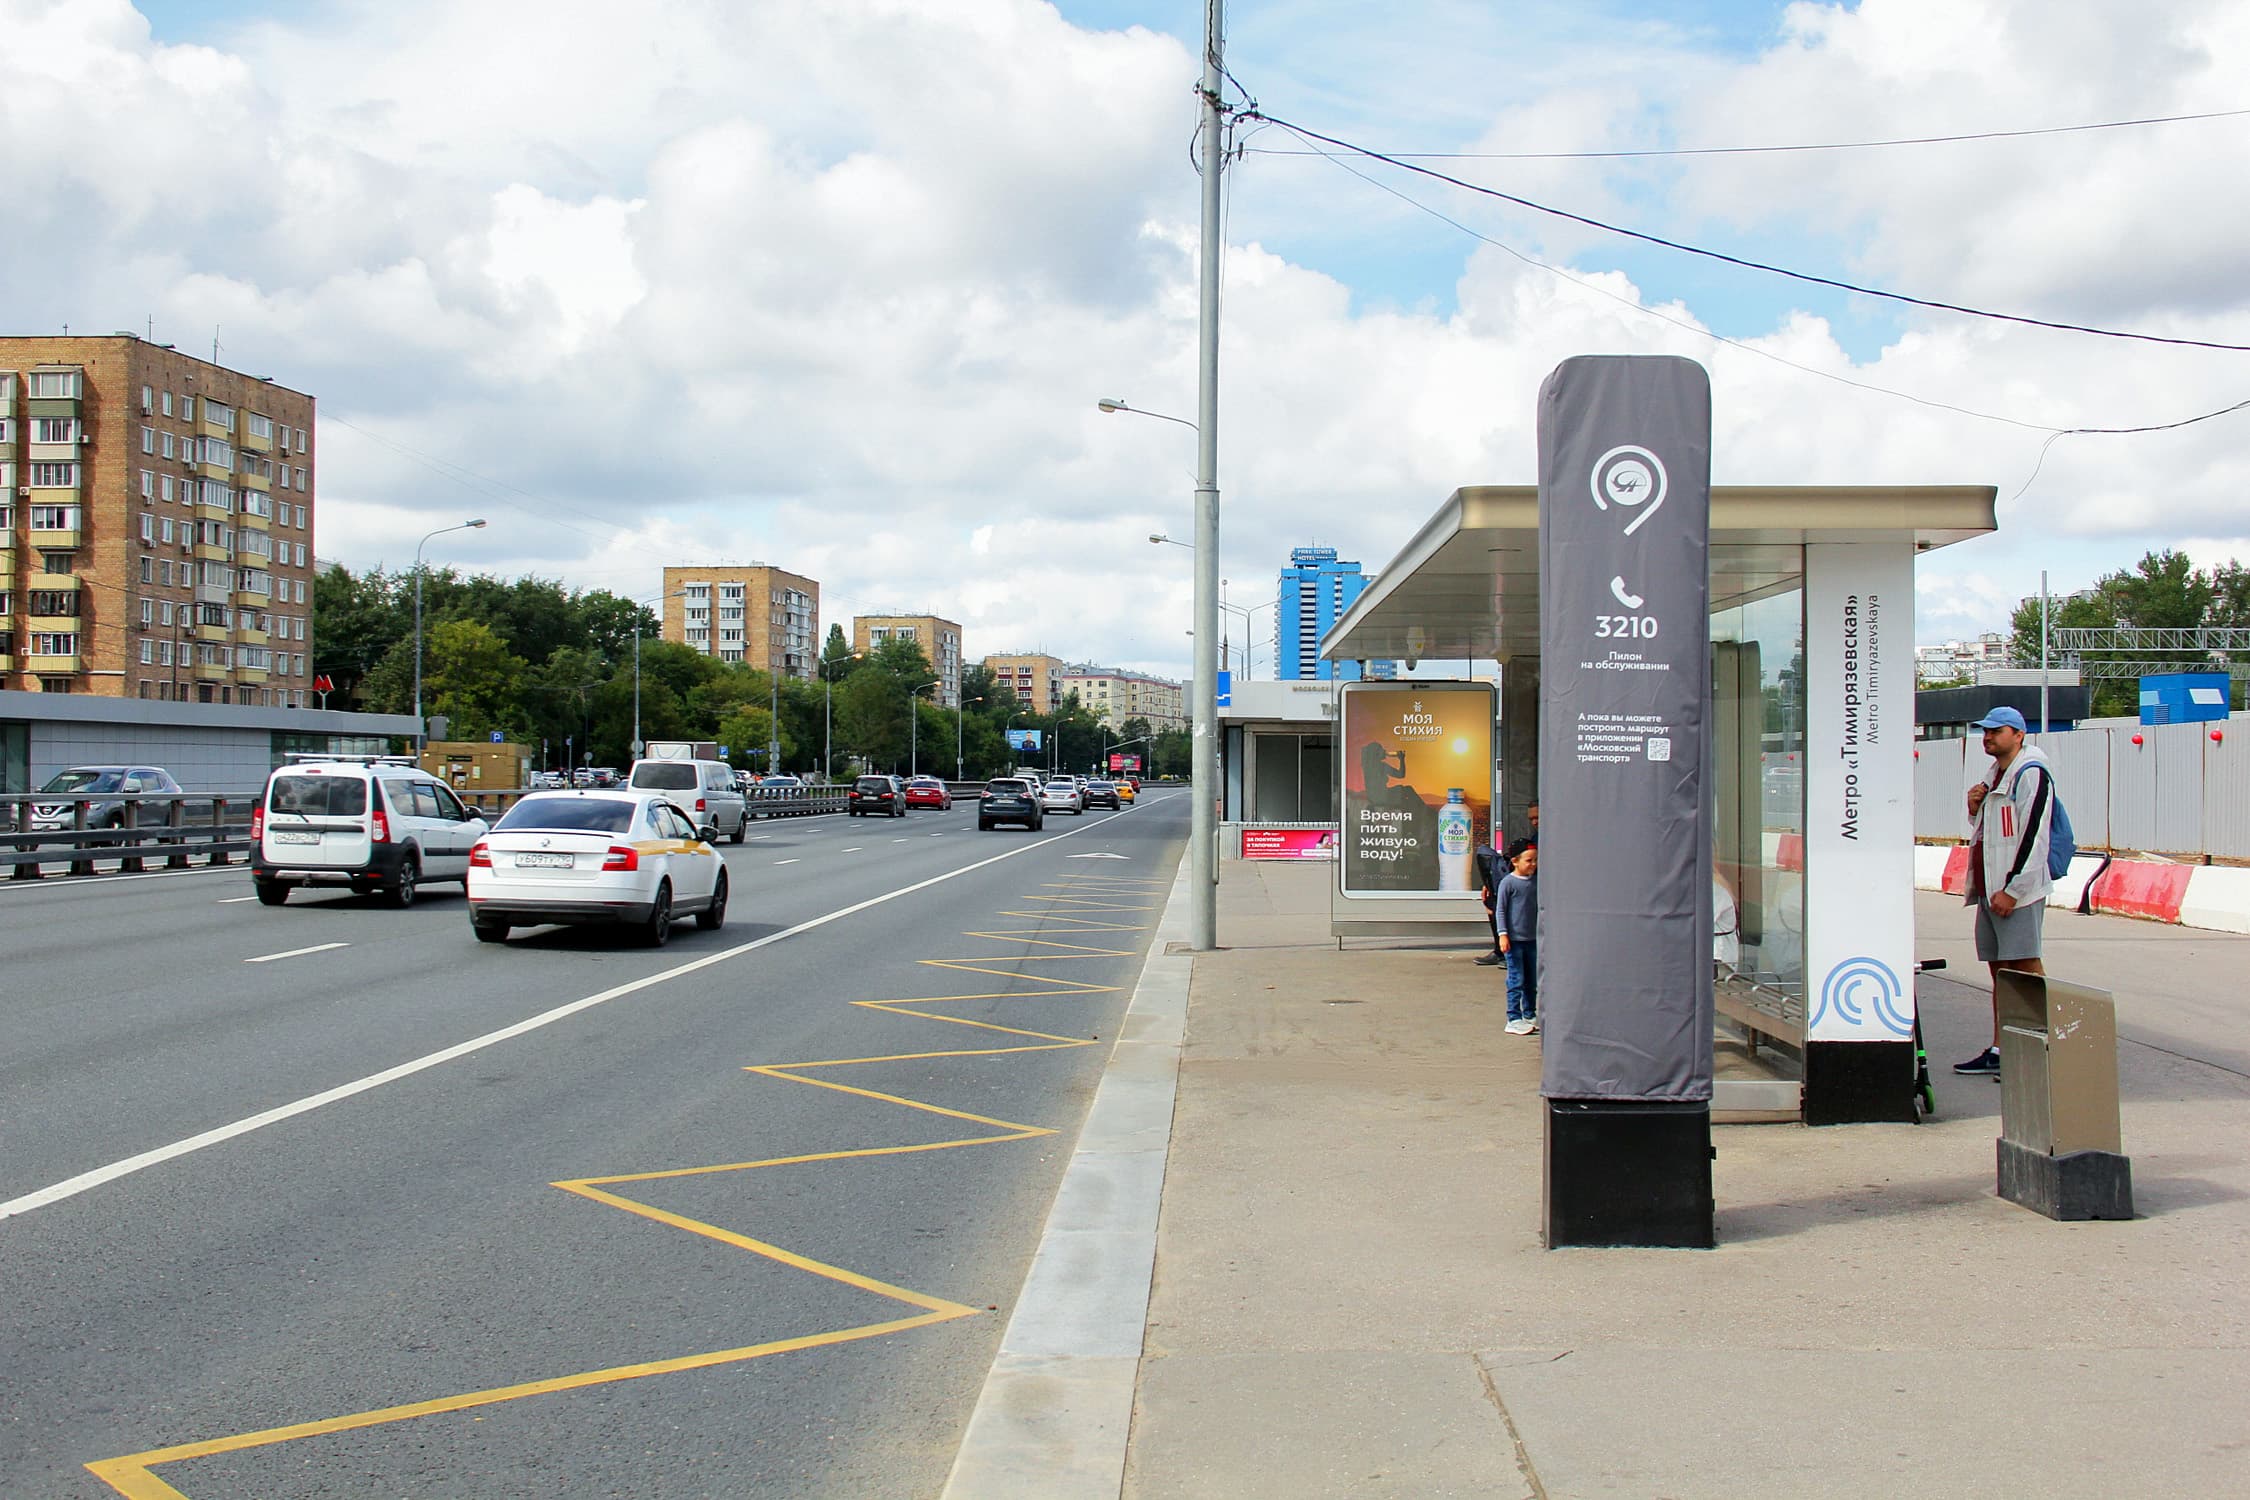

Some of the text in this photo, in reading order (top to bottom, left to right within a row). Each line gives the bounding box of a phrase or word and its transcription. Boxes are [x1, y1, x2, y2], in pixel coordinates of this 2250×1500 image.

[1594, 615, 1658, 639] 3210
[1609, 651, 1642, 661] Пилон
[1581, 660, 1670, 671] на обслуживании
[1866, 595, 1881, 744] Metro Timiryazevskaya
[1403, 714, 1433, 724] МОЯ
[1578, 712, 1585, 721] А
[1625, 715, 1662, 723] можете
[1841, 595, 1862, 840] Метро «Тимирязевская»
[1393, 725, 1443, 735] СТИХИЯ
[1577, 724, 1669, 735] построить маршрут
[1584, 734, 1643, 743] приложении
[1577, 743, 1641, 752] «Московский
[1577, 755, 1631, 764] транспорт»
[1360, 809, 1413, 823] Время
[1360, 825, 1398, 833] пить
[1360, 837, 1418, 849] живую
[1360, 848, 1404, 861] воду!
